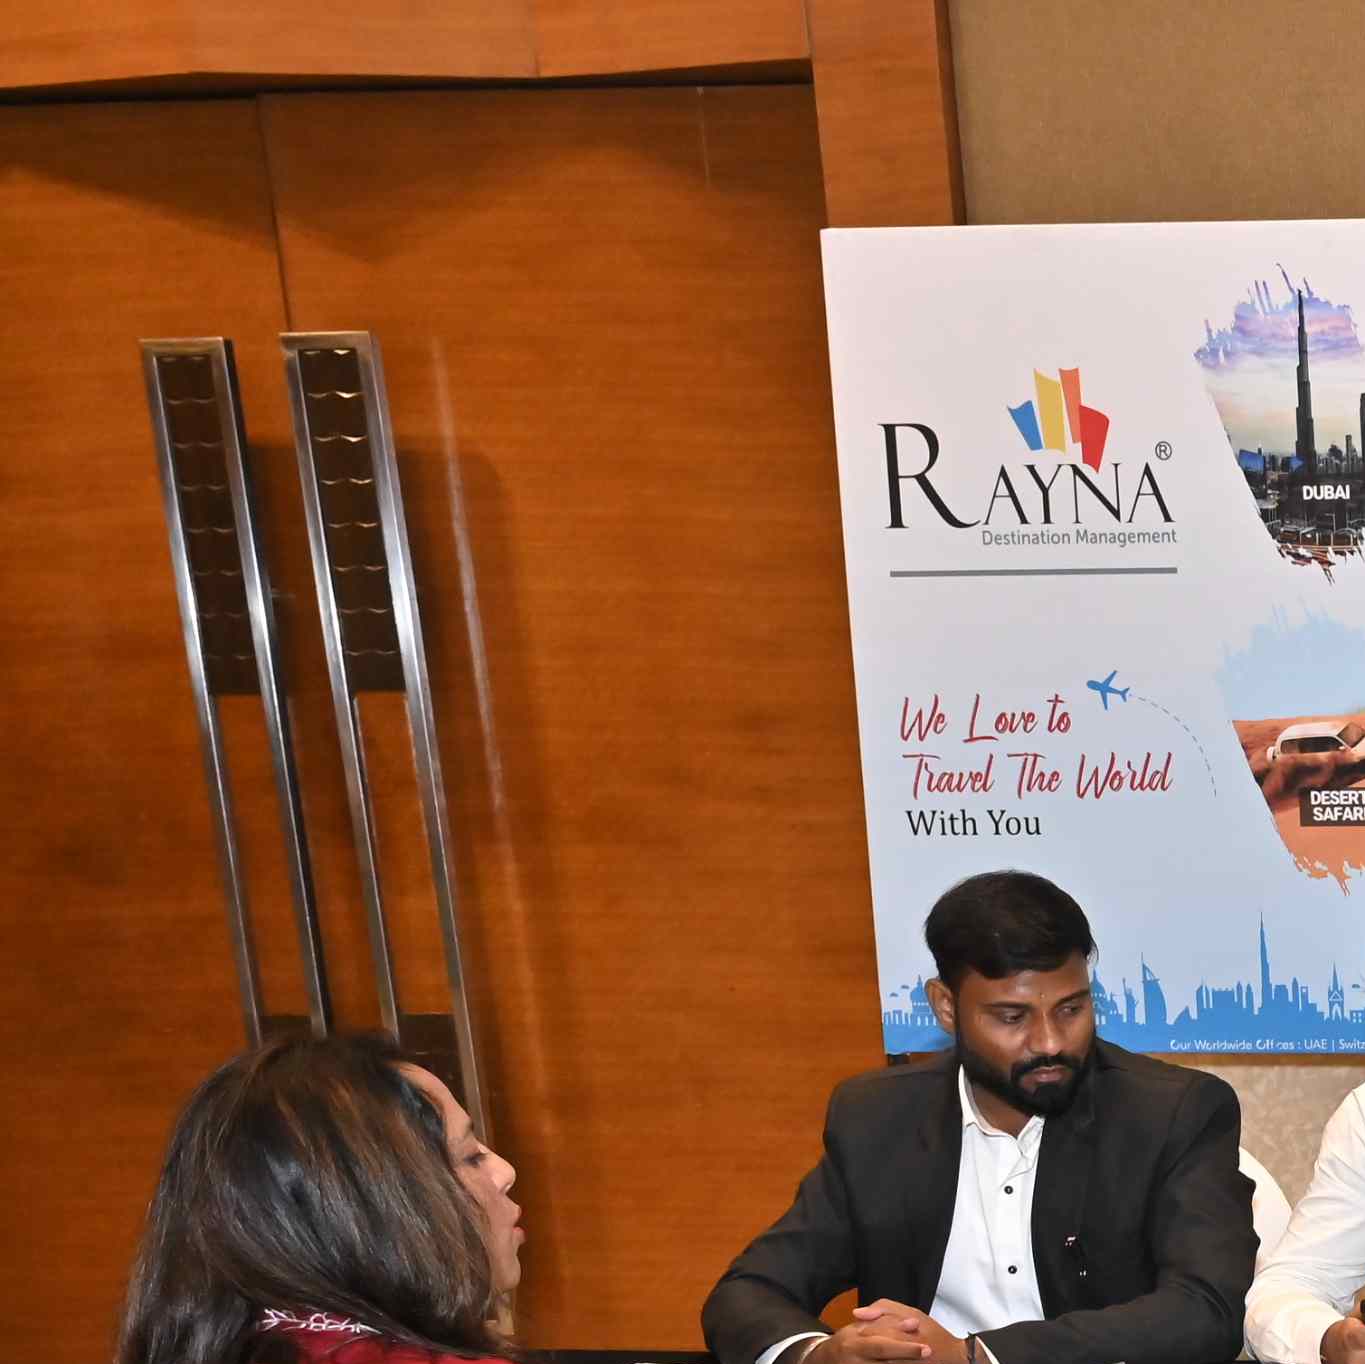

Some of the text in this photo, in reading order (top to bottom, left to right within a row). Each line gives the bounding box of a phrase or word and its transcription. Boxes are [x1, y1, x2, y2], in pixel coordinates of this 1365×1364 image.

[877, 423, 1176, 529] RAYNA
[1302, 484, 1350, 500] DUBAI
[982, 529, 1177, 548] Destination Management
[901, 693, 1072, 743] We Love to
[902, 751, 1174, 800] Travel The World
[906, 809, 1041, 836] With You
[1304, 1039, 1328, 1051] UAE
